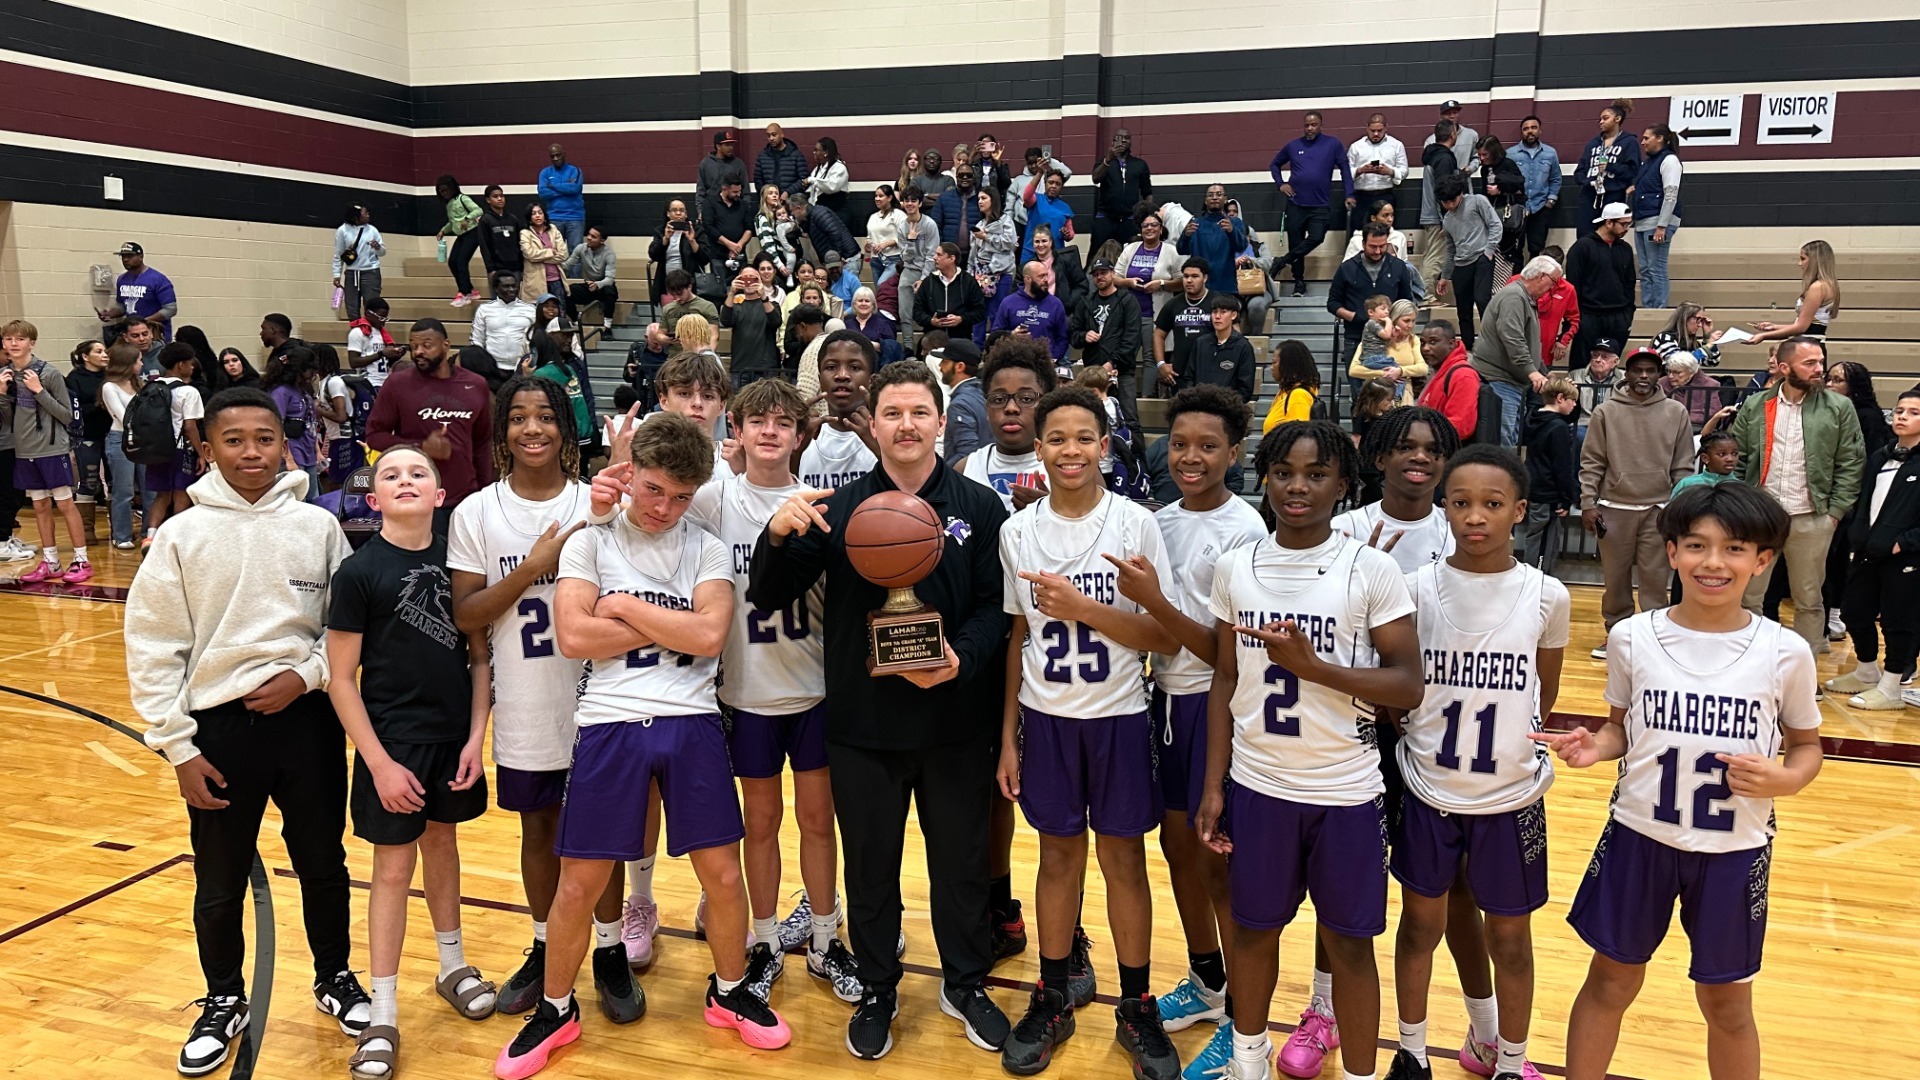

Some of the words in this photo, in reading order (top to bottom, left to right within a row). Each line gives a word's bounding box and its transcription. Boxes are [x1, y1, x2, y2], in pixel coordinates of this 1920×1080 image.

[1682, 99, 1730, 118] HOME
[1768, 96, 1828, 116] VISITOR
[417, 407, 473, 420] Horns
[1114, 476, 1124, 487] 3
[1029, 571, 1115, 610] CGERS
[399, 605, 459, 650] CHARGERS
[889, 626, 916, 635] LAMAR
[889, 651, 931, 660] CHAMPIONS
[893, 645, 926, 653] DISTRICT
[1041, 620, 1112, 684] 25
[1423, 648, 1529, 692] CHARGERS
[1263, 663, 1302, 738] 2
[1643, 689, 1761, 740] CHARGERS
[1435, 699, 1498, 775] 11
[1652, 745, 1736, 832] 12
